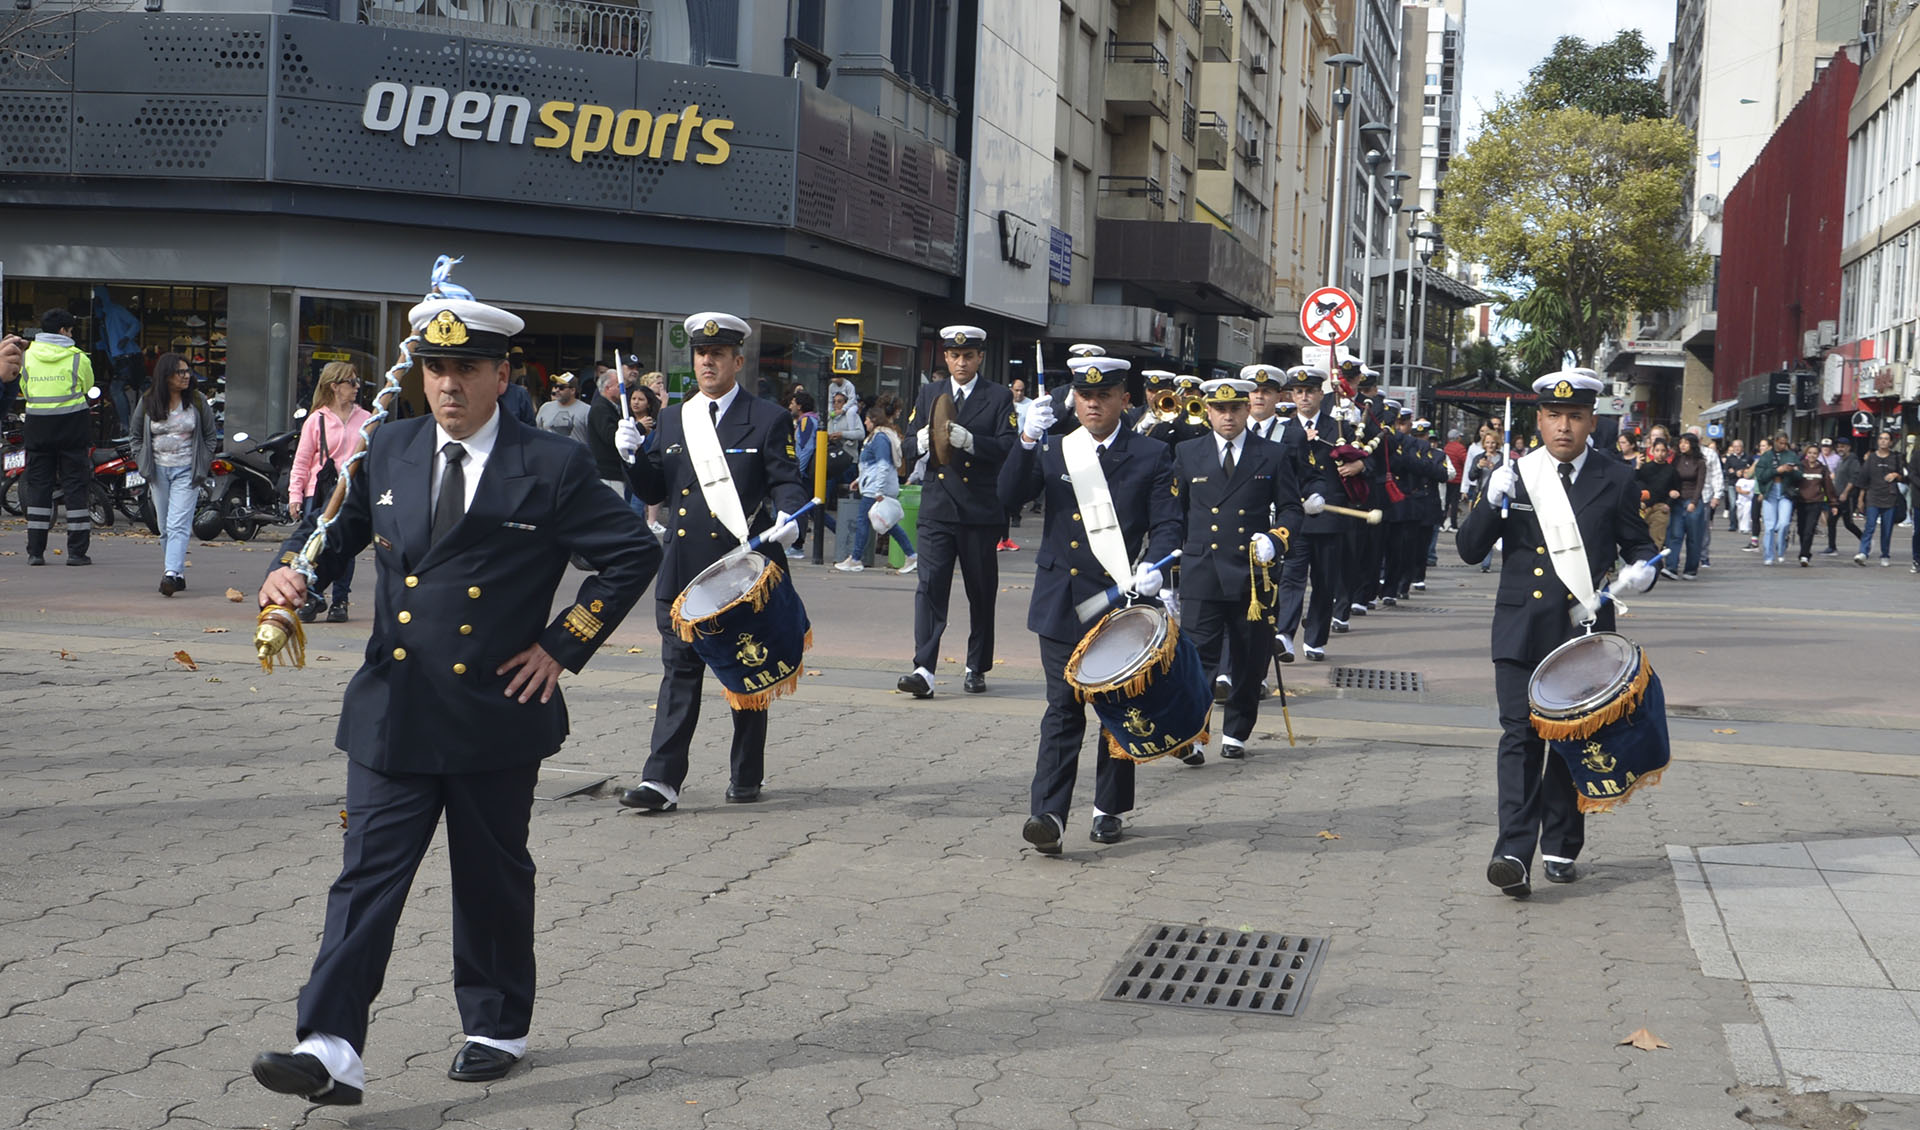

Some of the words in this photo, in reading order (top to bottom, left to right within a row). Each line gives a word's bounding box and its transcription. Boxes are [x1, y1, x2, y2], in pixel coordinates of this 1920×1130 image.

[363, 82, 531, 146] open
[533, 100, 734, 165] sports
[743, 660, 795, 692] A.R.A.
[1129, 734, 1181, 755] A.R.A.
[1586, 771, 1640, 796] A.R.A.
